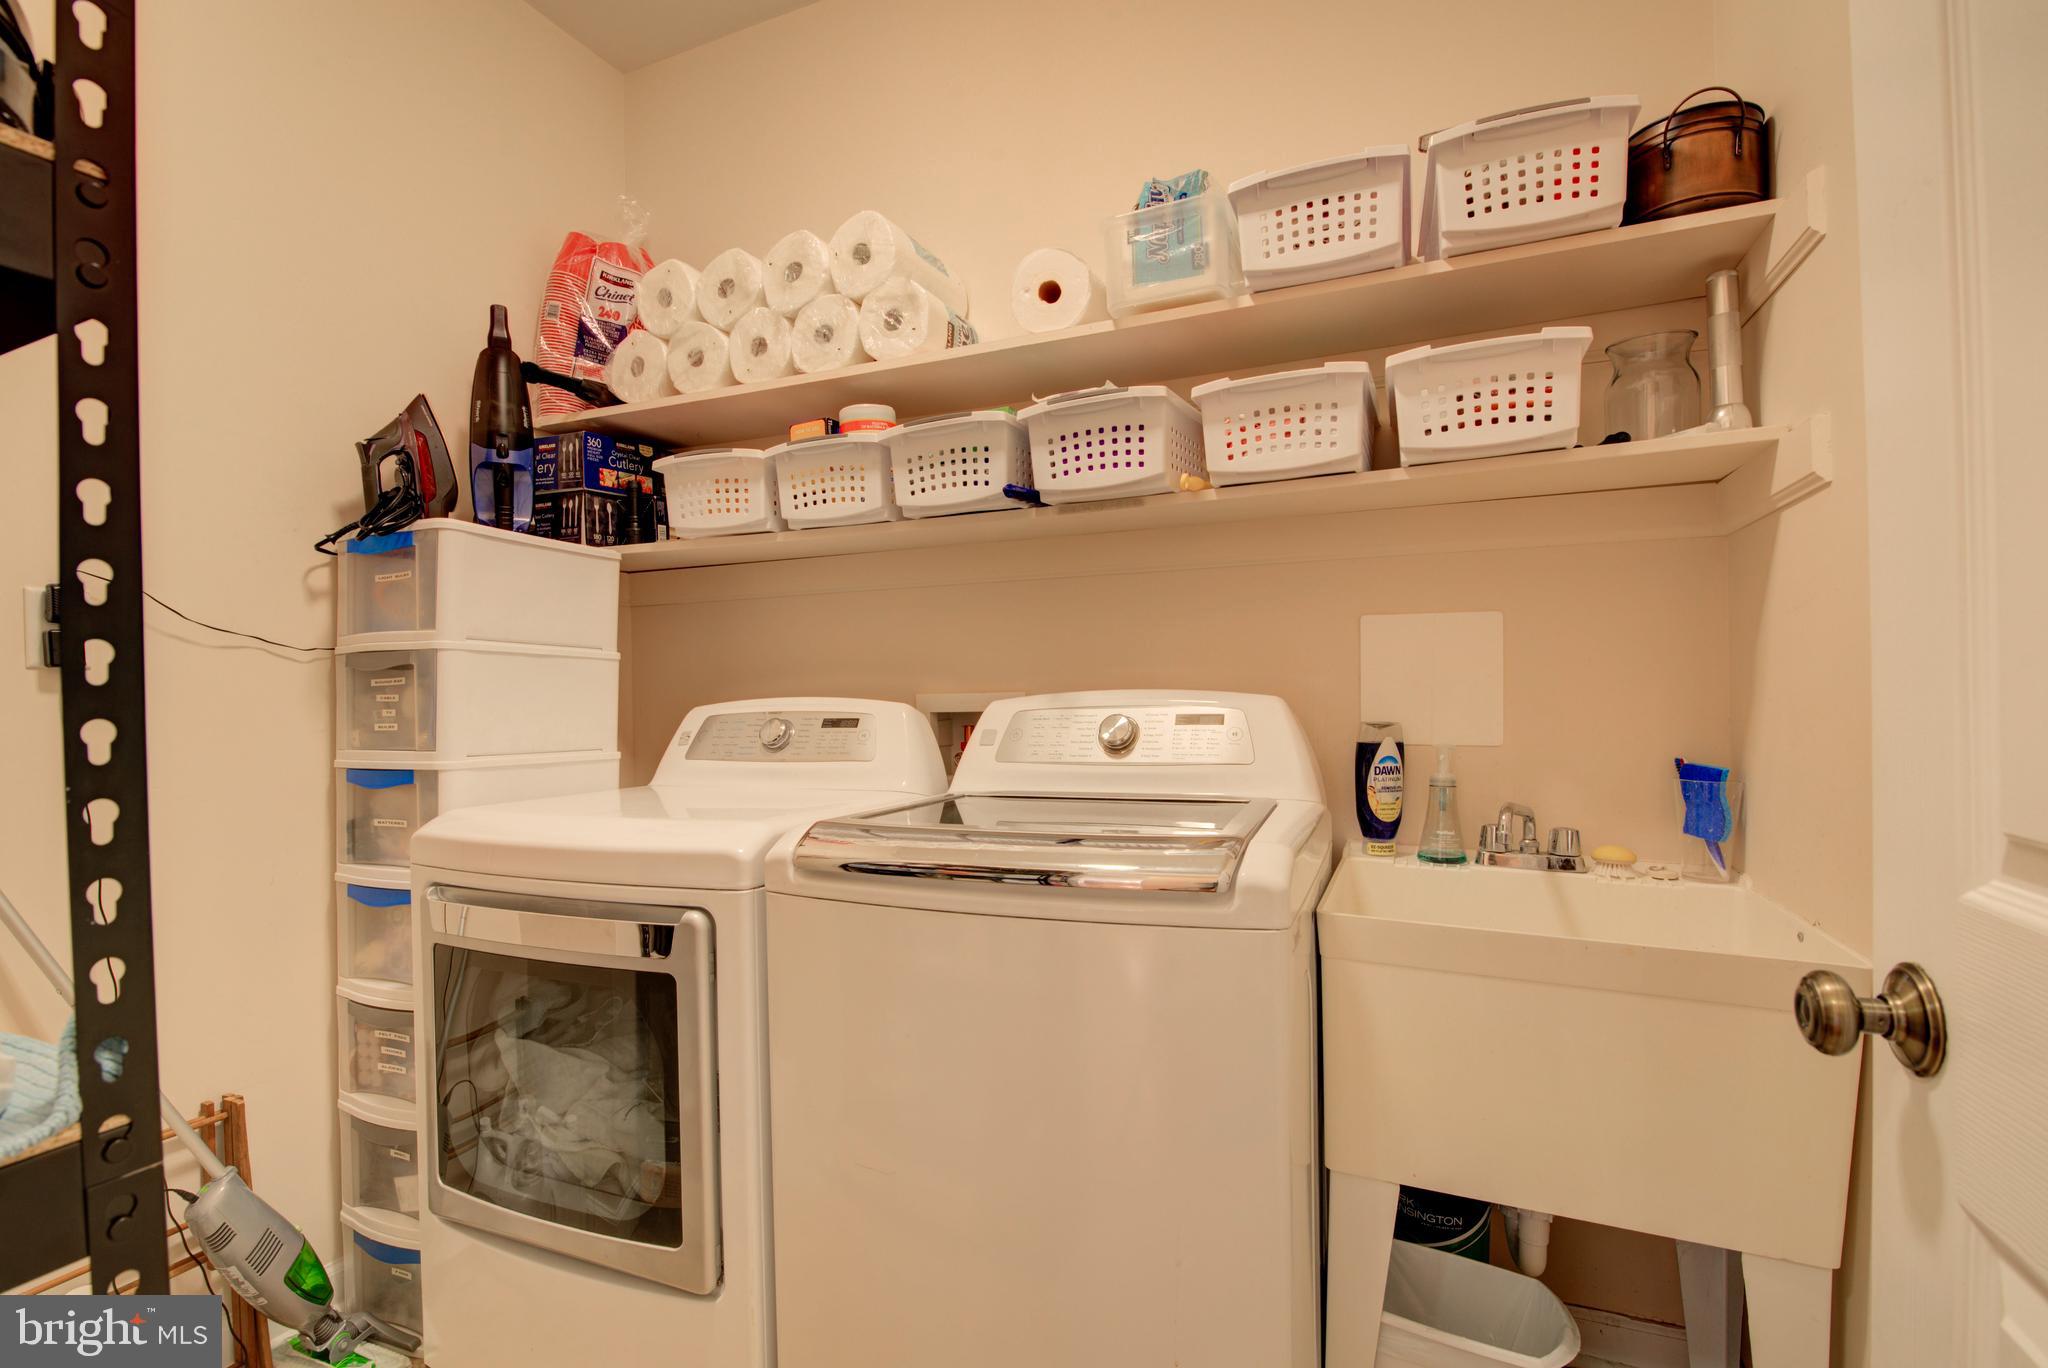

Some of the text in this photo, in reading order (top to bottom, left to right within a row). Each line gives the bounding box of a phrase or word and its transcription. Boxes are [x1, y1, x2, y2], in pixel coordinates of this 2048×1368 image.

[594, 285, 636, 301] Chinet
[586, 435, 602, 448] 360
[608, 456, 644, 474] Cutlery
[1374, 766, 1401, 776] DAWN
